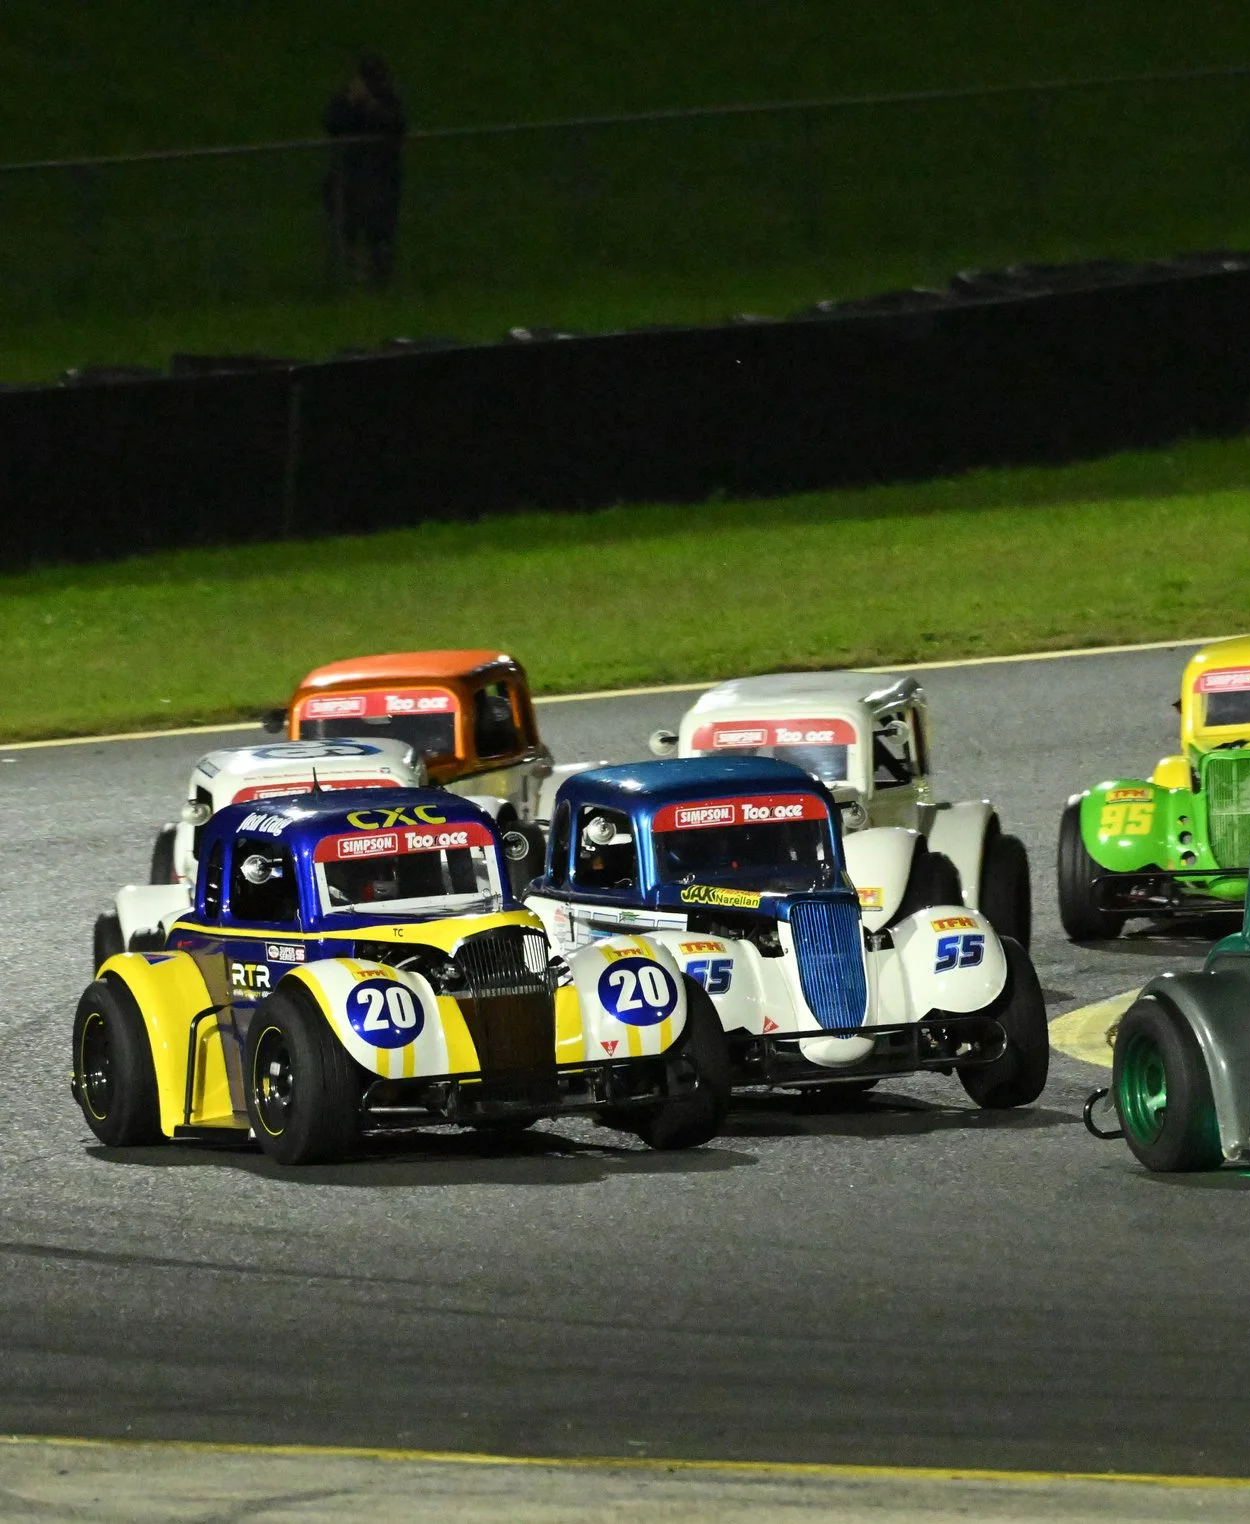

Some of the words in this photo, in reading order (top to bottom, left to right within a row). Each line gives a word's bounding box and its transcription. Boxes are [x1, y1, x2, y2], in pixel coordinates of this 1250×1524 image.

[346, 805, 446, 830] CXC
[680, 807, 730, 823] SIMPSON
[1099, 803, 1156, 836] 95
[343, 836, 393, 853] SIMPSON
[715, 894, 759, 907] Narellan
[393, 928, 404, 938] TC
[933, 917, 974, 929] TFH
[681, 942, 721, 953] TFH
[933, 933, 985, 974] 55
[232, 963, 271, 989] RTR
[685, 959, 734, 995] 55
[608, 966, 670, 1013] 20
[356, 986, 417, 1033] 20
